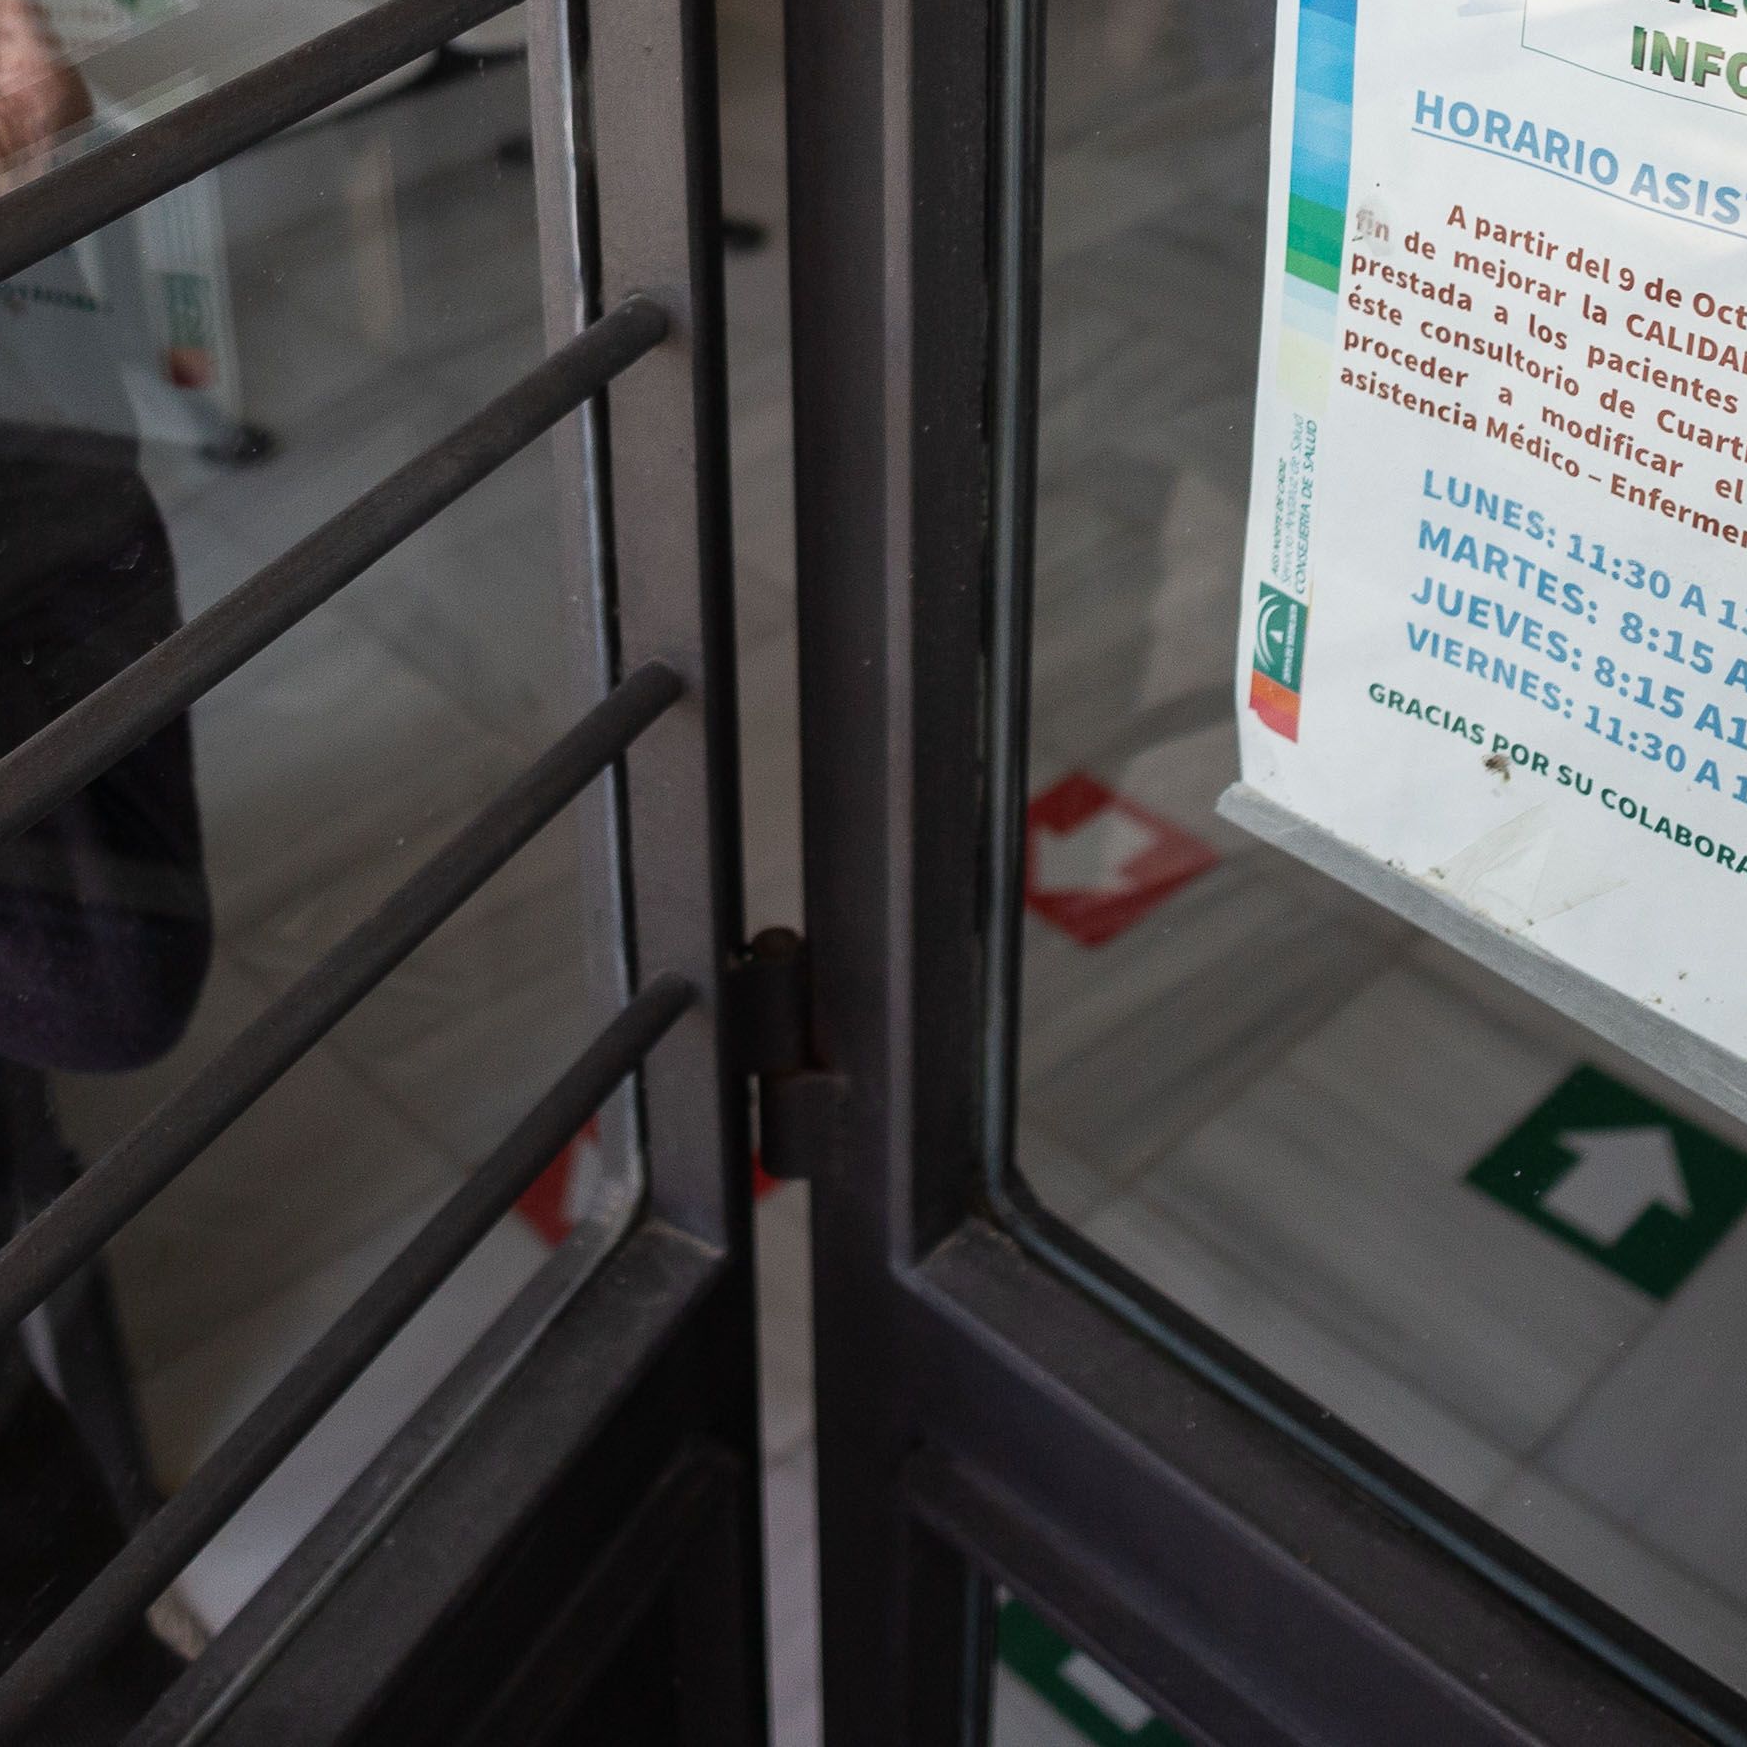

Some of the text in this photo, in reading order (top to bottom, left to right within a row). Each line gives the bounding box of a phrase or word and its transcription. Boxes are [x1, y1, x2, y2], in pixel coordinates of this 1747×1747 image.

[1414, 89, 1619, 186] HORARIO
[1355, 208, 1389, 242] fin
[1404, 231, 1436, 260] de
[1453, 249, 1567, 308] mejorar
[1582, 294, 1607, 326] la
[1446, 204, 1466, 229] A
[1474, 215, 1559, 261] partir
[1566, 246, 1610, 284] del
[1619, 267, 1635, 292] 9
[1644, 277, 1682, 309] de
[1348, 283, 1403, 326] éste
[1420, 319, 1580, 397] consultorio
[1599, 388, 1635, 420] de
[1351, 252, 1473, 313] prestada
[1494, 304, 1509, 325] a
[1528, 313, 1568, 351] los
[1587, 344, 1739, 415] pacientes
[1291, 412, 1305, 452] Salud
[1302, 419, 1318, 473] SALUD
[1340, 365, 1477, 431] asistencia
[1485, 416, 1580, 478] Médico
[1344, 327, 1469, 388] proceder
[1498, 387, 1513, 406] a
[1541, 405, 1684, 478] modificar
[1715, 478, 1744, 504] el
[1301, 476, 1314, 500] DE
[1423, 468, 1555, 549] LUNES:
[1567, 533, 1670, 600] 11:30
[1679, 583, 1707, 617] A
[1411, 576, 1582, 672] JUEVES:
[1594, 655, 1685, 719] 8:15
[1418, 518, 1598, 625] MARTES:
[1619, 611, 1714, 675] 8:15
[1368, 682, 1485, 745] GRACIAS
[1492, 733, 1549, 778] POR
[1558, 763, 1593, 797] SU
[1406, 621, 1574, 720] VIERNES:
[1584, 705, 1686, 773] 11:30
[1693, 758, 1721, 792] A
